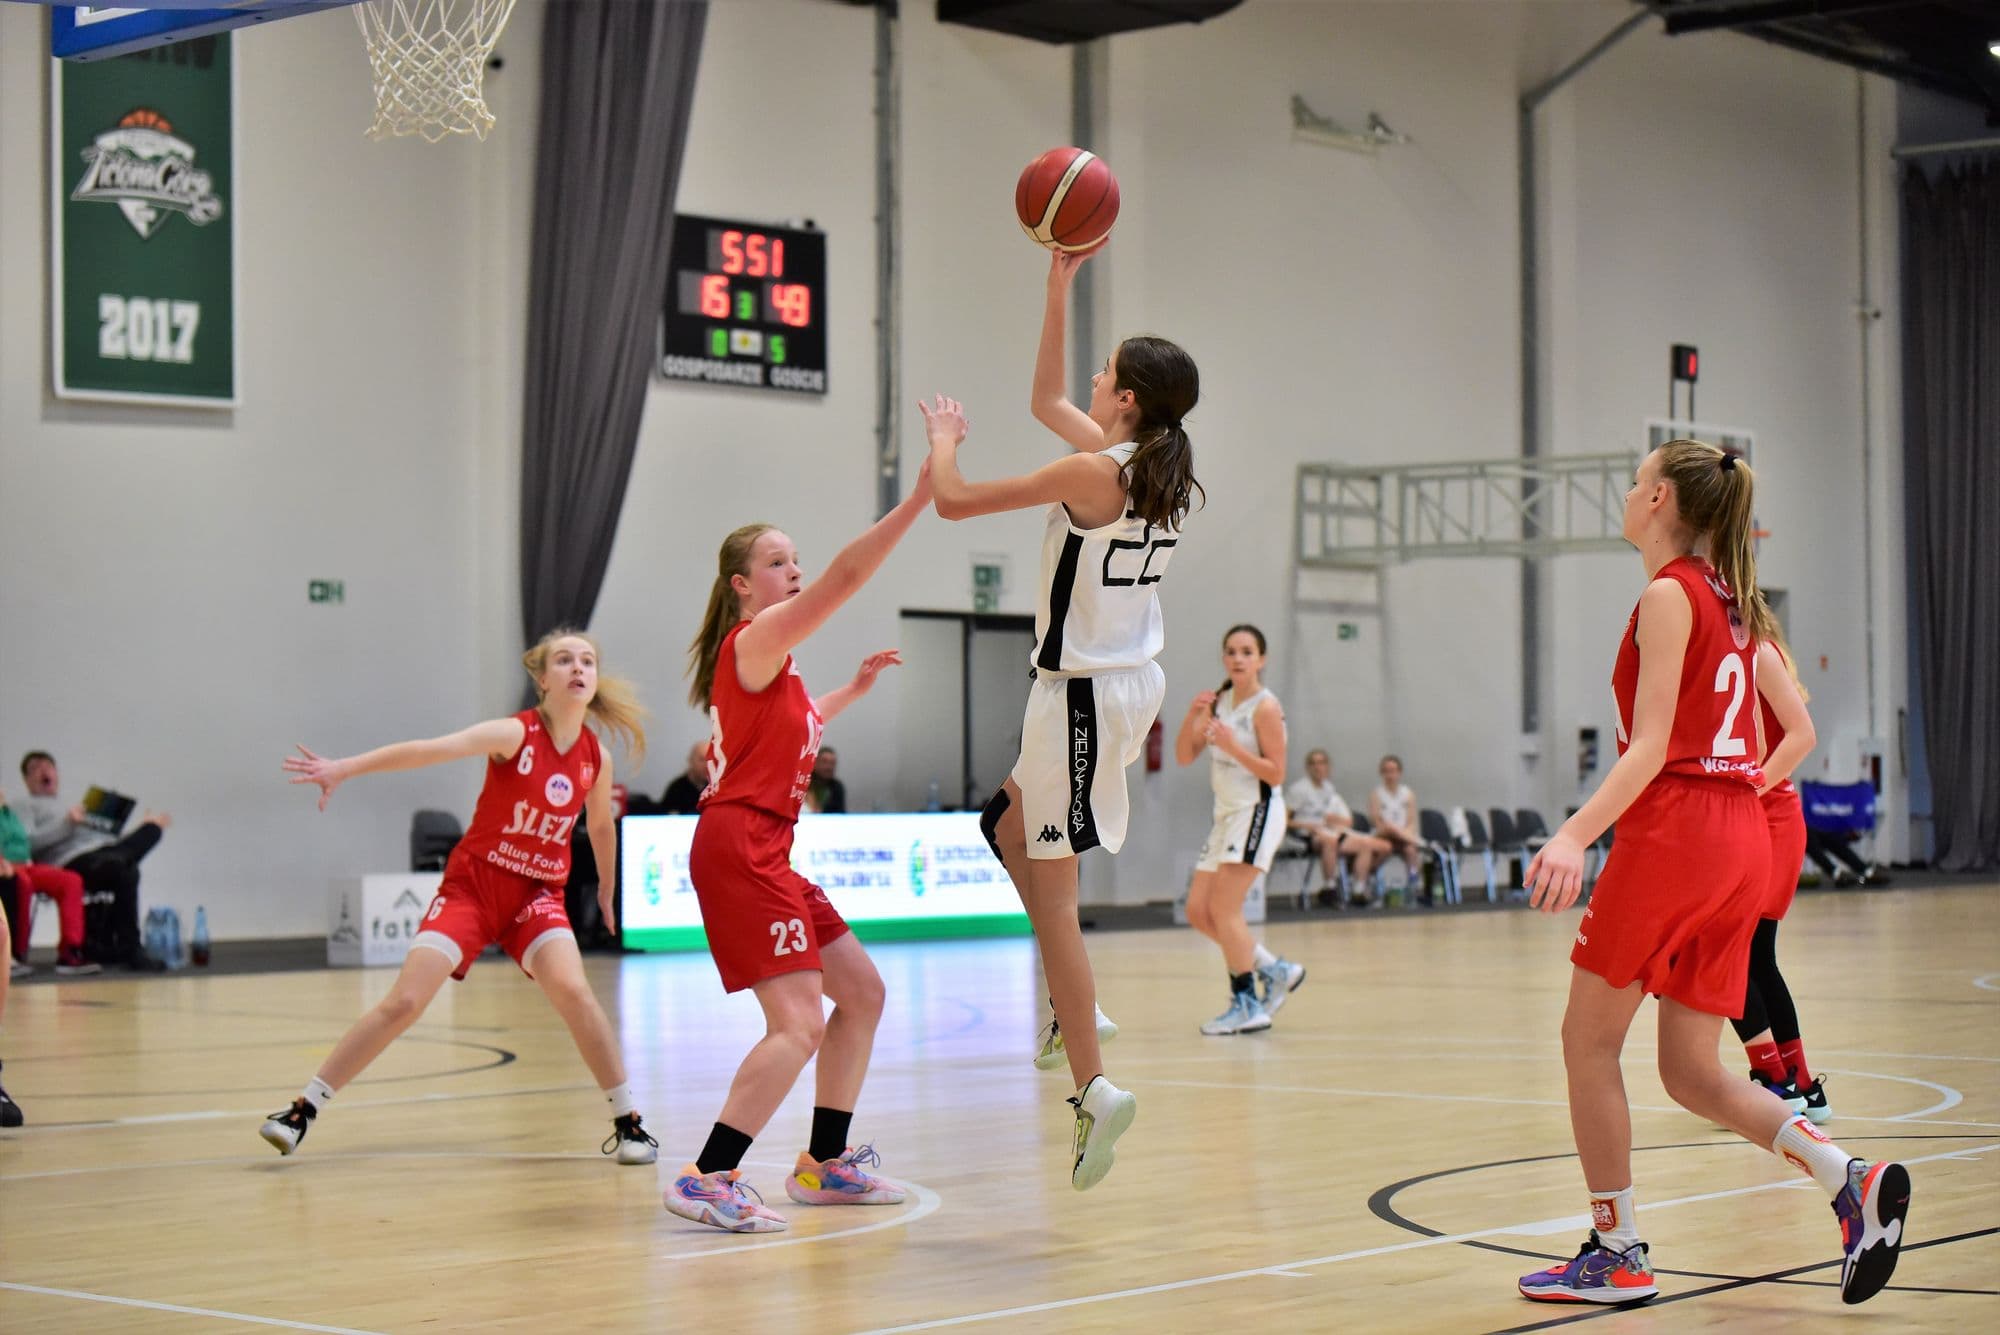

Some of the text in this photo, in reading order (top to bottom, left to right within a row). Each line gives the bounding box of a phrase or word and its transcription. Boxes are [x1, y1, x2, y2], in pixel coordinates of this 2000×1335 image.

[736, 290, 753, 320] 3
[98, 293, 200, 364] 2017
[769, 334, 786, 364] 5
[517, 745, 535, 775] 6
[1074, 727, 1089, 791] ZIELONA
[498, 841, 530, 863] Blue
[427, 896, 447, 922] 6
[769, 918, 809, 957] 23
